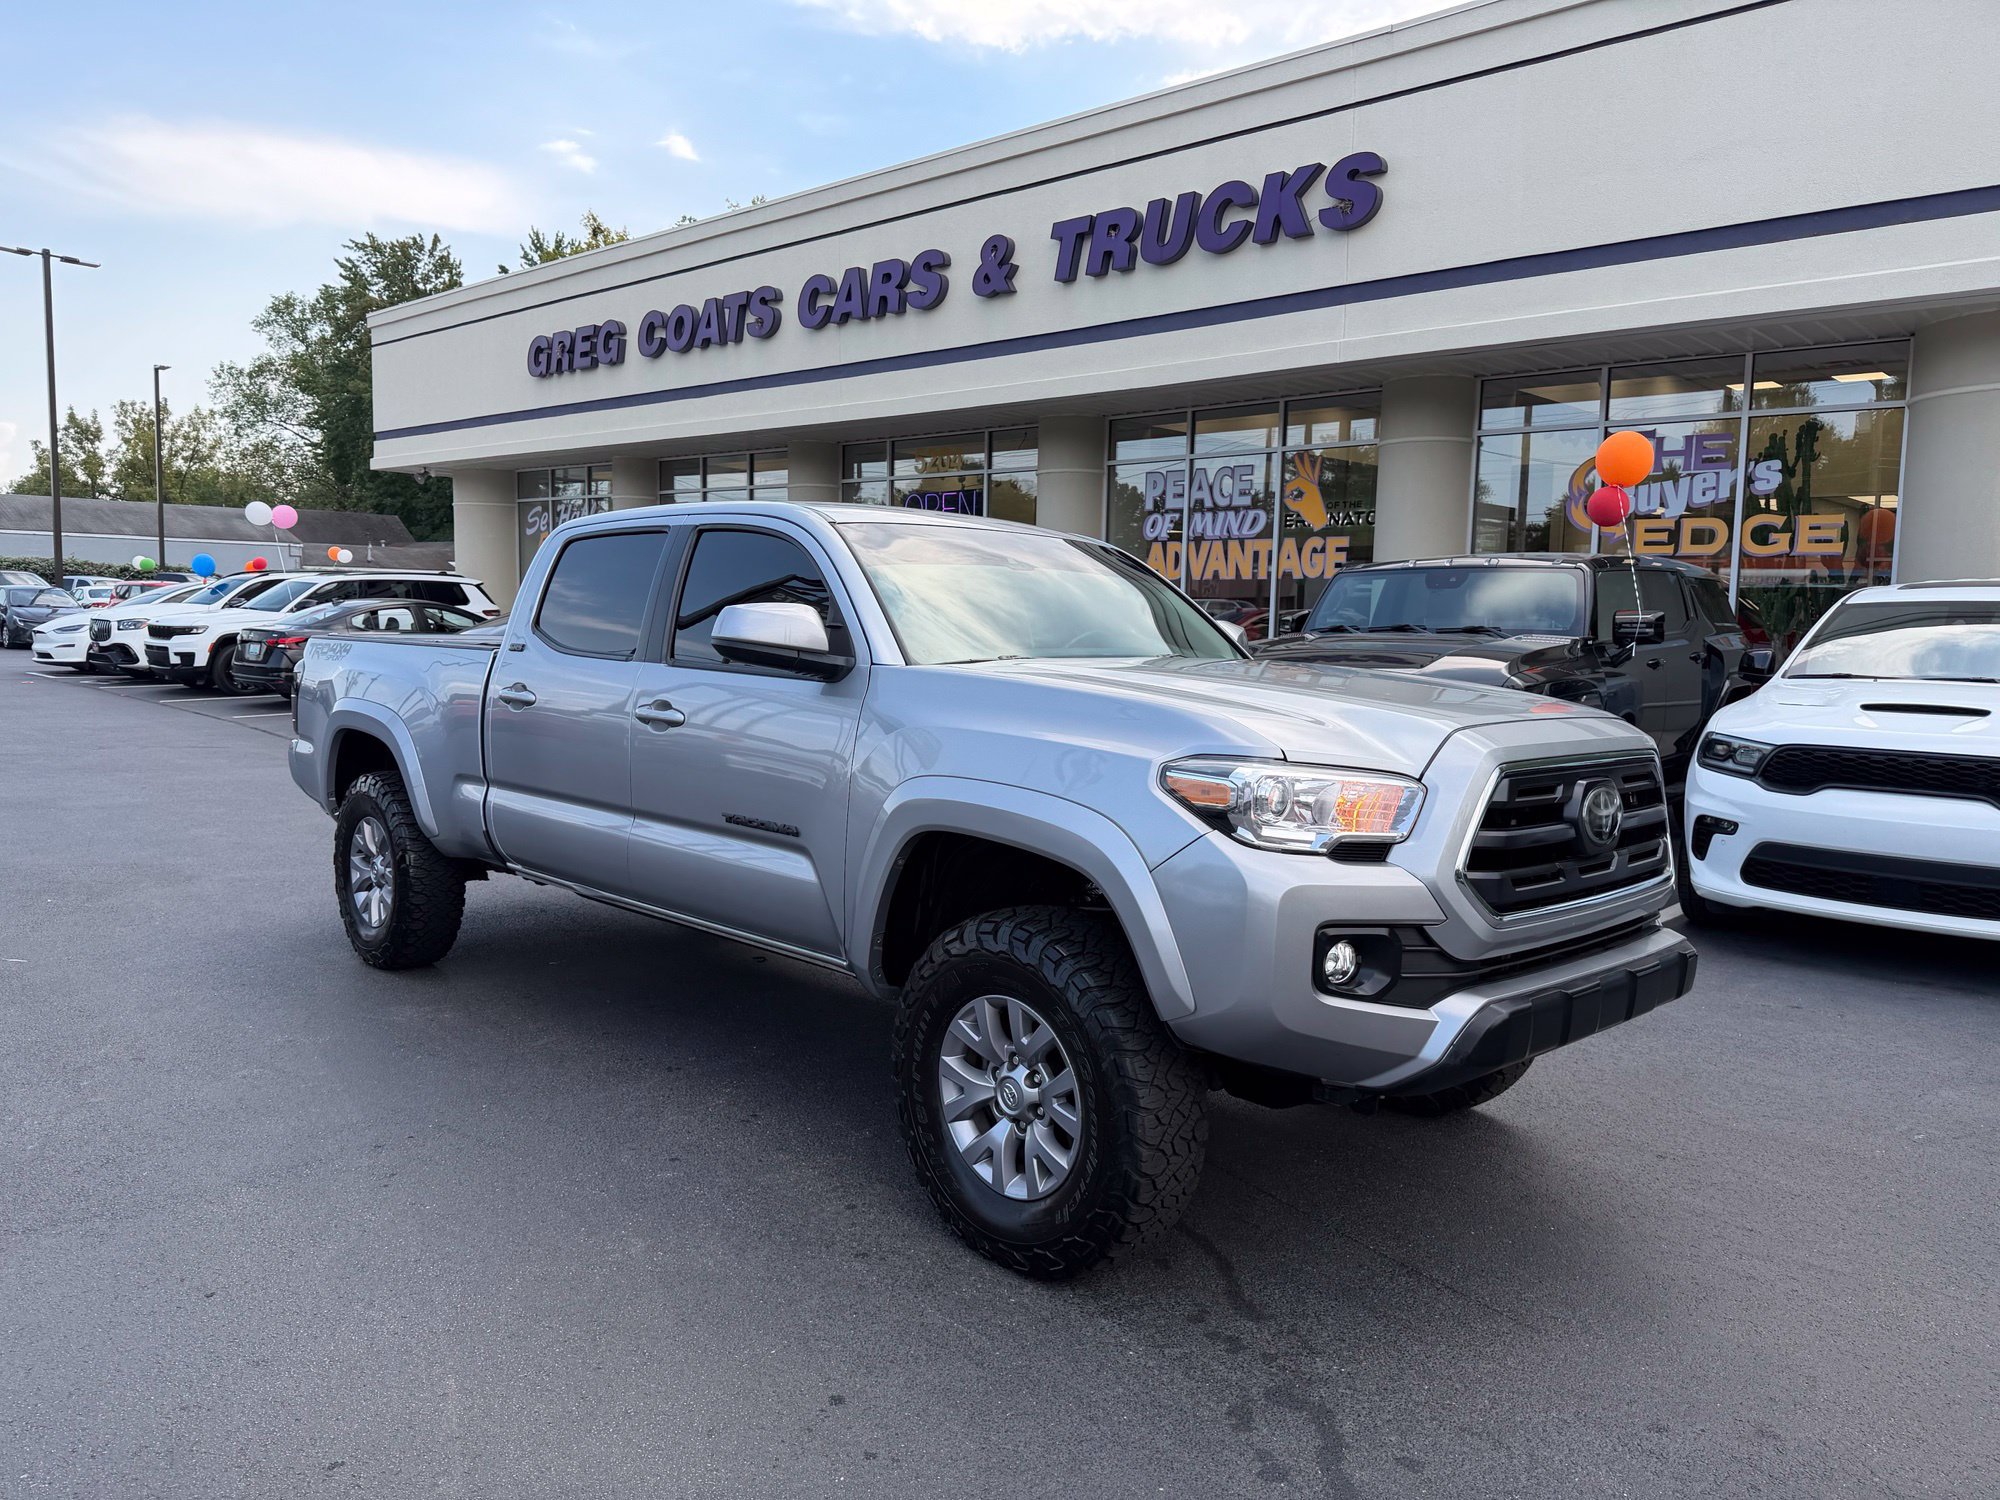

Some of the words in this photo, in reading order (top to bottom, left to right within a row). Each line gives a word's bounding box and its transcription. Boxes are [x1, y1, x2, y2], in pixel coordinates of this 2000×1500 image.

[527, 319, 627, 378] GREG
[638, 285, 783, 358] COATS
[798, 249, 951, 330] CARS
[972, 234, 1019, 298] &
[1050, 151, 1388, 282] TRUCKS
[1606, 427, 1734, 474] HE
[1144, 464, 1255, 512] PEACE
[525, 505, 549, 536] Se
[1142, 512, 1180, 541] OF
[1189, 508, 1268, 541] MIND
[1631, 512, 1847, 557] EDGE
[1146, 536, 1350, 581] ADVANTAGE
